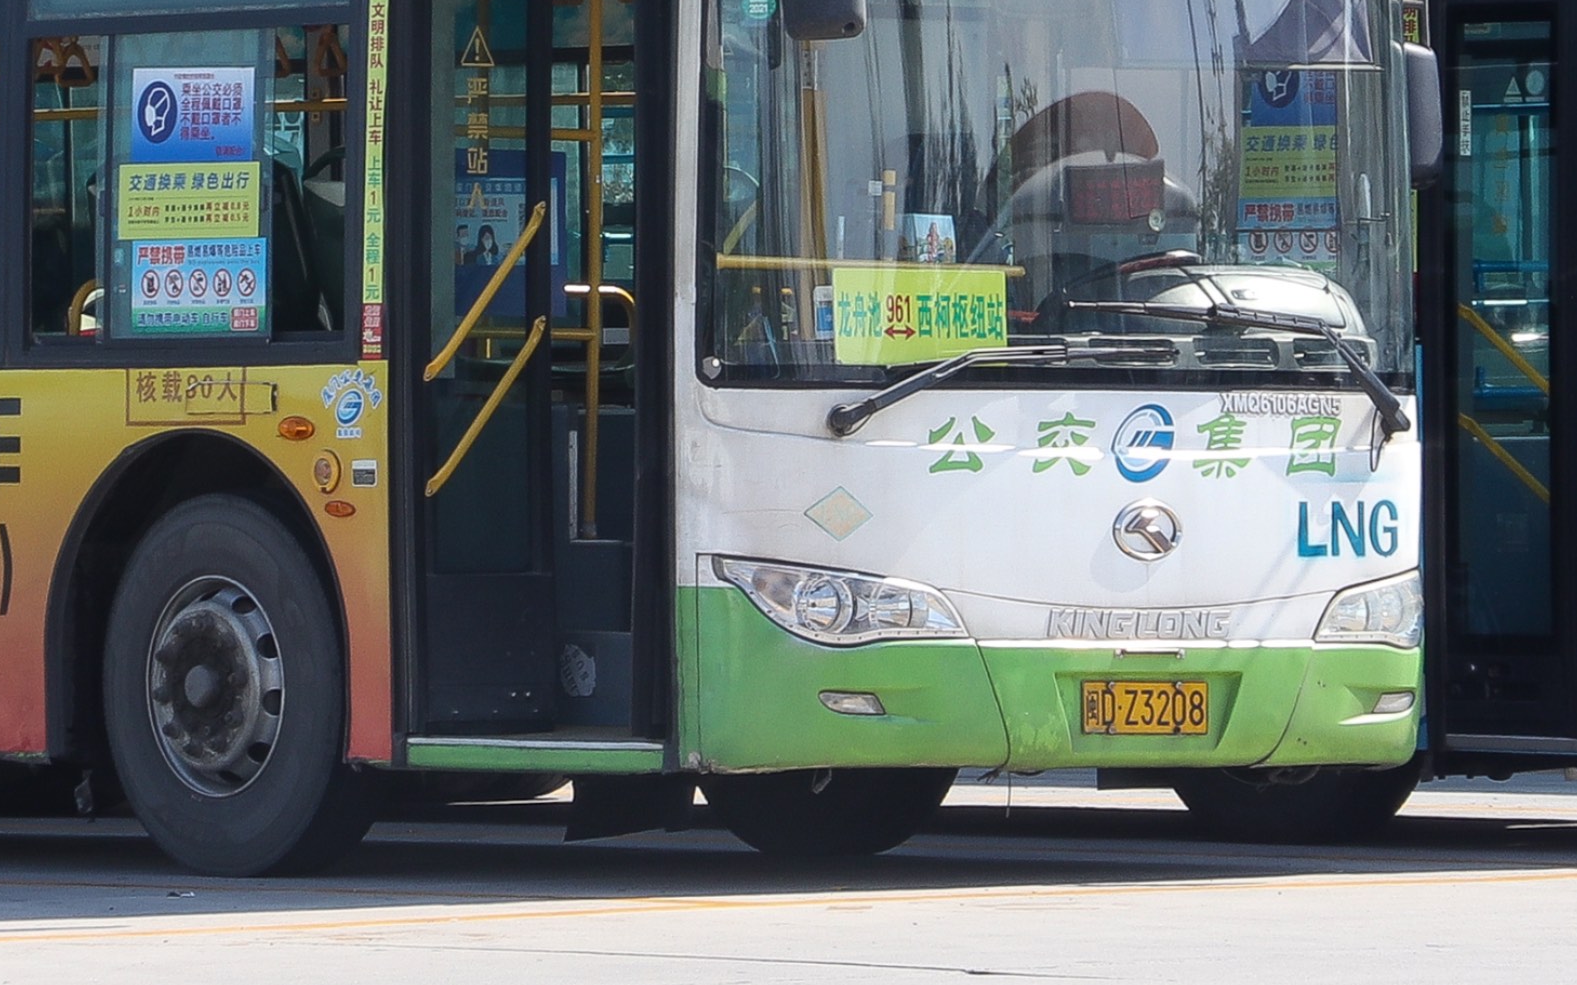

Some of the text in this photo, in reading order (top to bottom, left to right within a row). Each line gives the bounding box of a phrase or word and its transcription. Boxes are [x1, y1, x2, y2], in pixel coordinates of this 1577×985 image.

[370, 3, 385, 68] 文明排队
[368, 80, 383, 145] 礼让上车
[128, 172, 250, 192] 交通换乘 绿色出行
[138, 245, 186, 265] 严禁携带
[838, 291, 1004, 340] 龙舟池 961 西柯枢纽站
[1298, 500, 1399, 558] LNG
